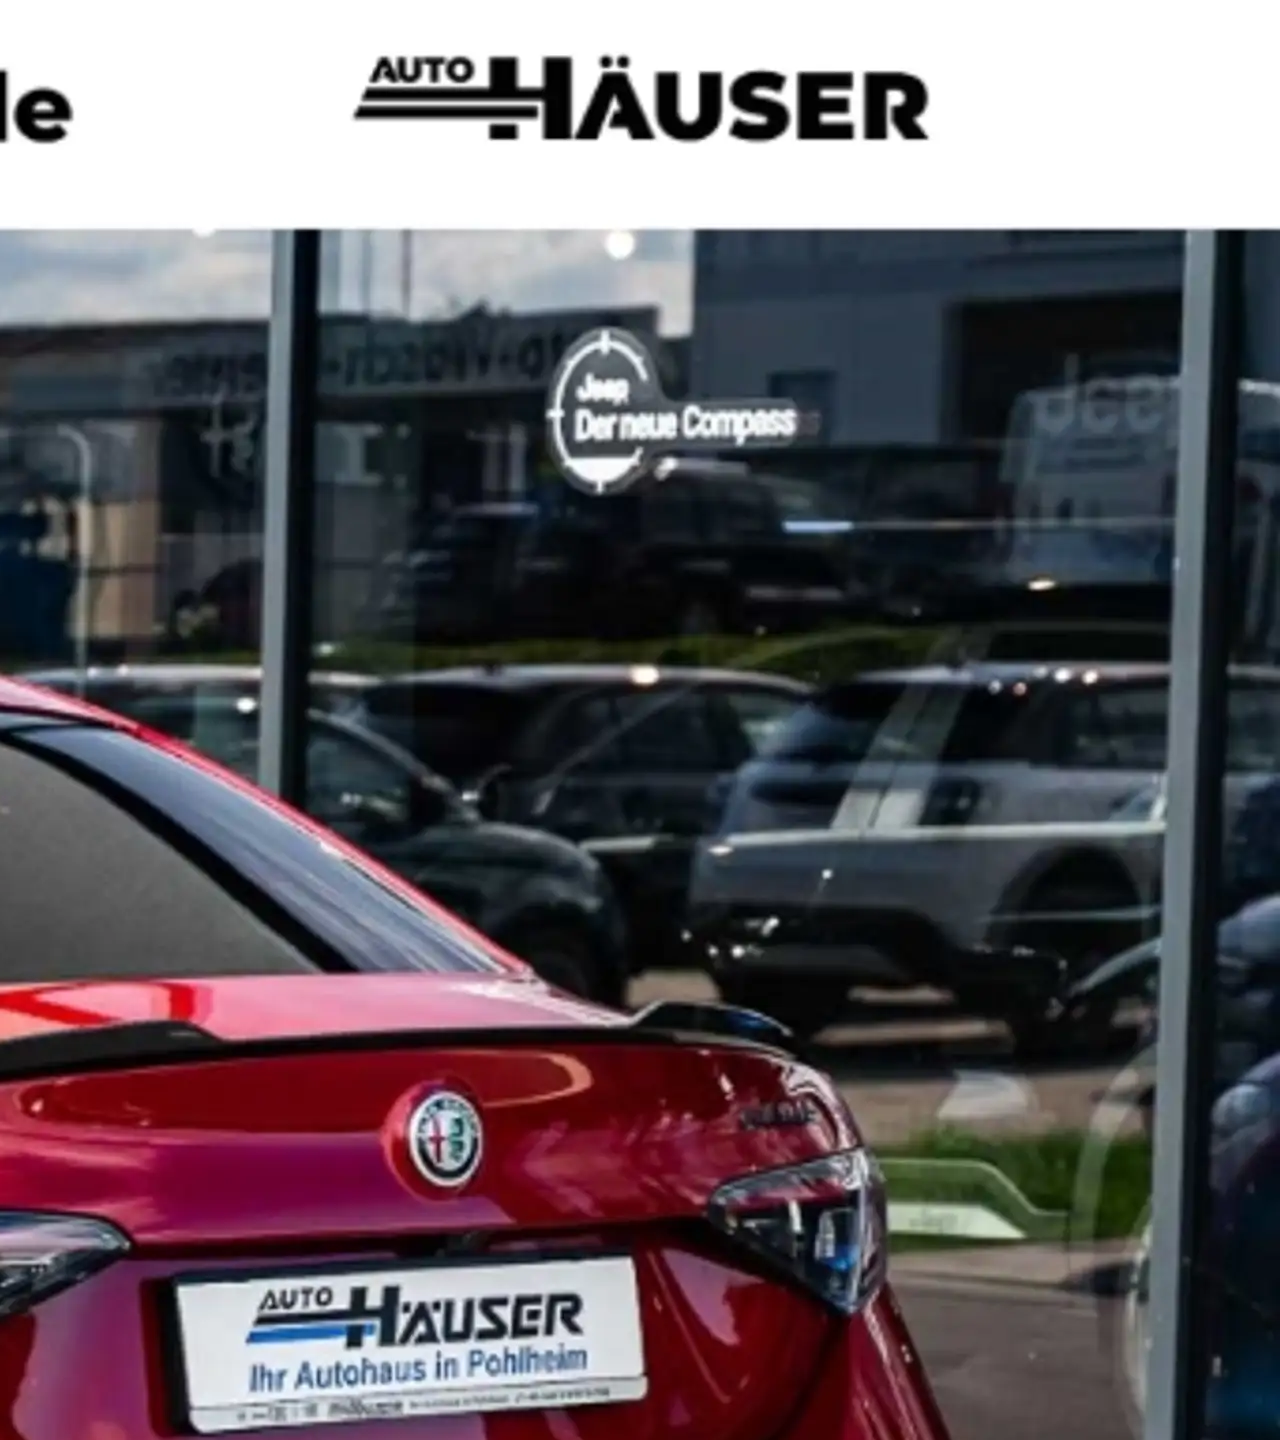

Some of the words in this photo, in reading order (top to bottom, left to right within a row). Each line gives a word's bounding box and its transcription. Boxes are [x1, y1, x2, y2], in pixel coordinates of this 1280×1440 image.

[574, 373, 631, 404] Jeep
[574, 409, 617, 442] Der
[620, 410, 678, 440] neue
[683, 404, 798, 447] Compass
[258, 1286, 333, 1311] AUTO
[344, 1284, 584, 1349] HÄUSER
[248, 1362, 286, 1394] Ihr
[294, 1355, 427, 1391] Autohaus
[436, 1350, 459, 1380] in
[467, 1343, 589, 1378] Pohlheim
